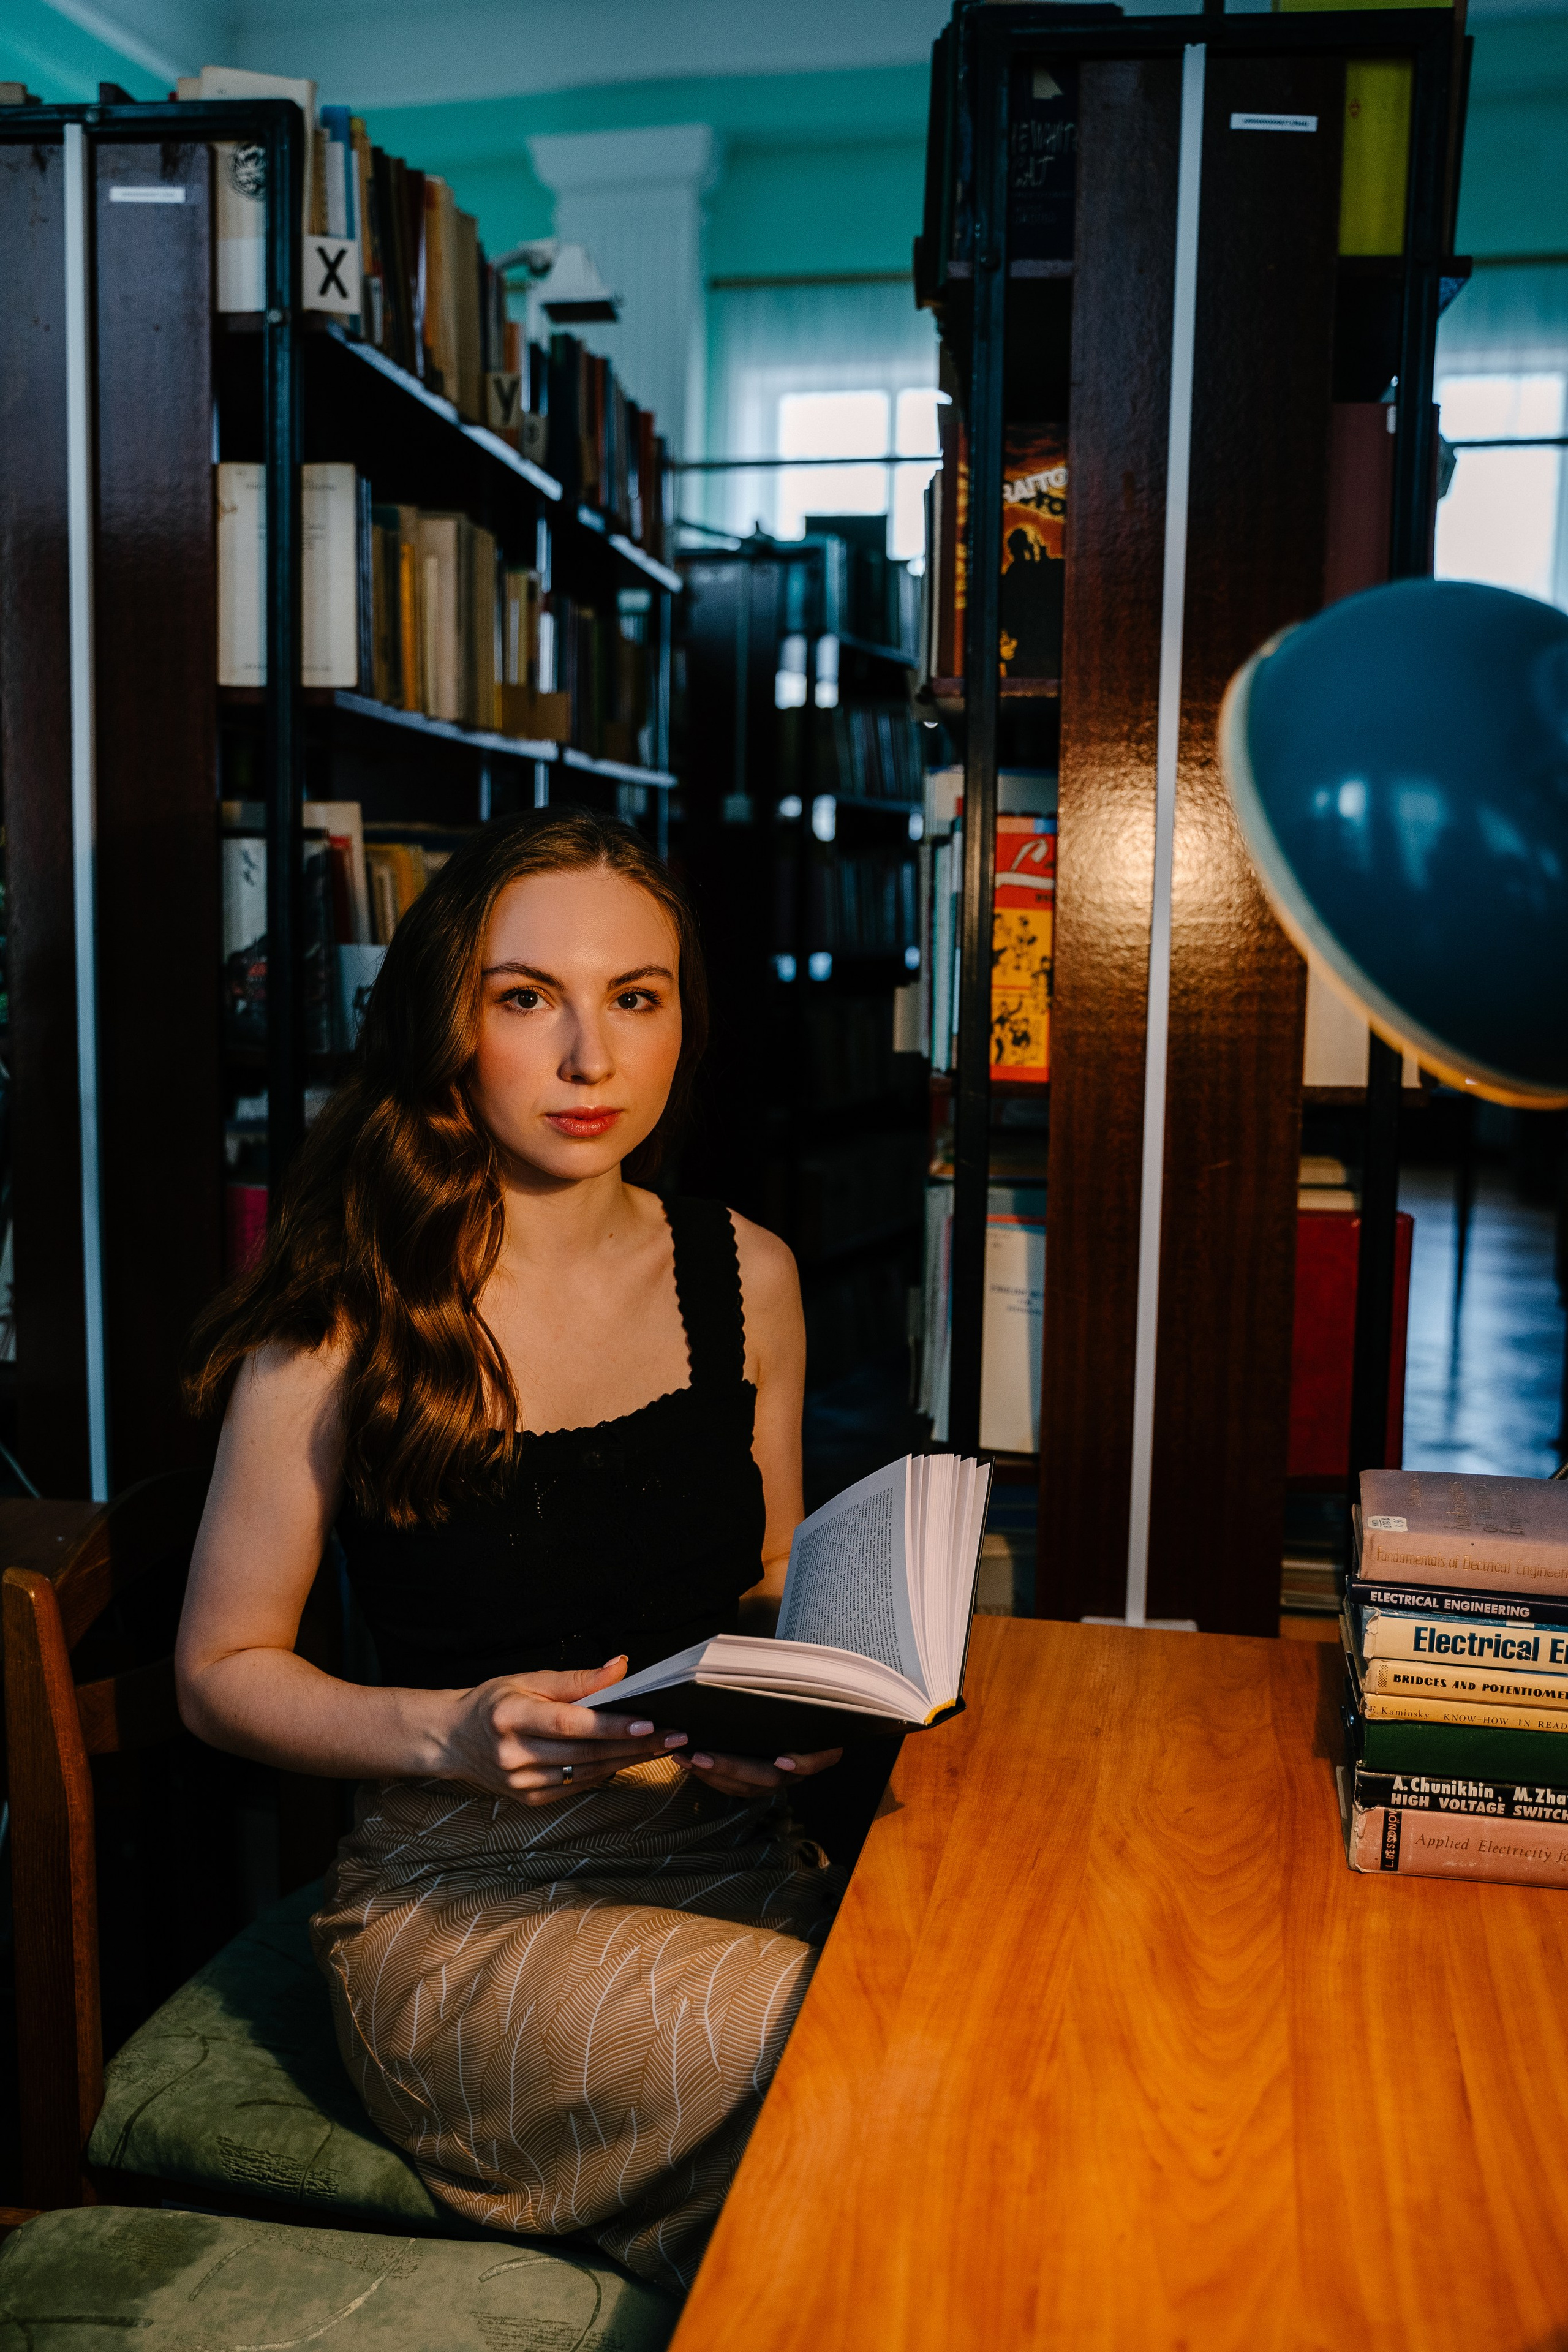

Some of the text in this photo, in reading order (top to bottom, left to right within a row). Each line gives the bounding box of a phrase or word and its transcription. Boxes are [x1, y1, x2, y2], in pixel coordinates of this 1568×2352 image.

[316, 246, 349, 299] X
[1376, 1546, 1446, 1568] Fundamentals
[1449, 1557, 1458, 1569] of
[1463, 1555, 1511, 1574] Electrical
[1370, 1591, 1530, 1618] ELECTRICAL ENGINEERING
[1413, 1626, 1540, 1662] Electrical
[1393, 1674, 1447, 1688] BRIDGES
[1452, 1680, 1476, 1691] AND
[1443, 1713, 1509, 1725] KNOW-HOW
[1518, 1719, 1531, 1727] IN
[1390, 1793, 1430, 1807] HIGH
[1439, 1797, 1506, 1815] VOLTAGE
[1415, 1833, 1470, 1850] Applied
[1477, 1840, 1552, 1863] Electricity
